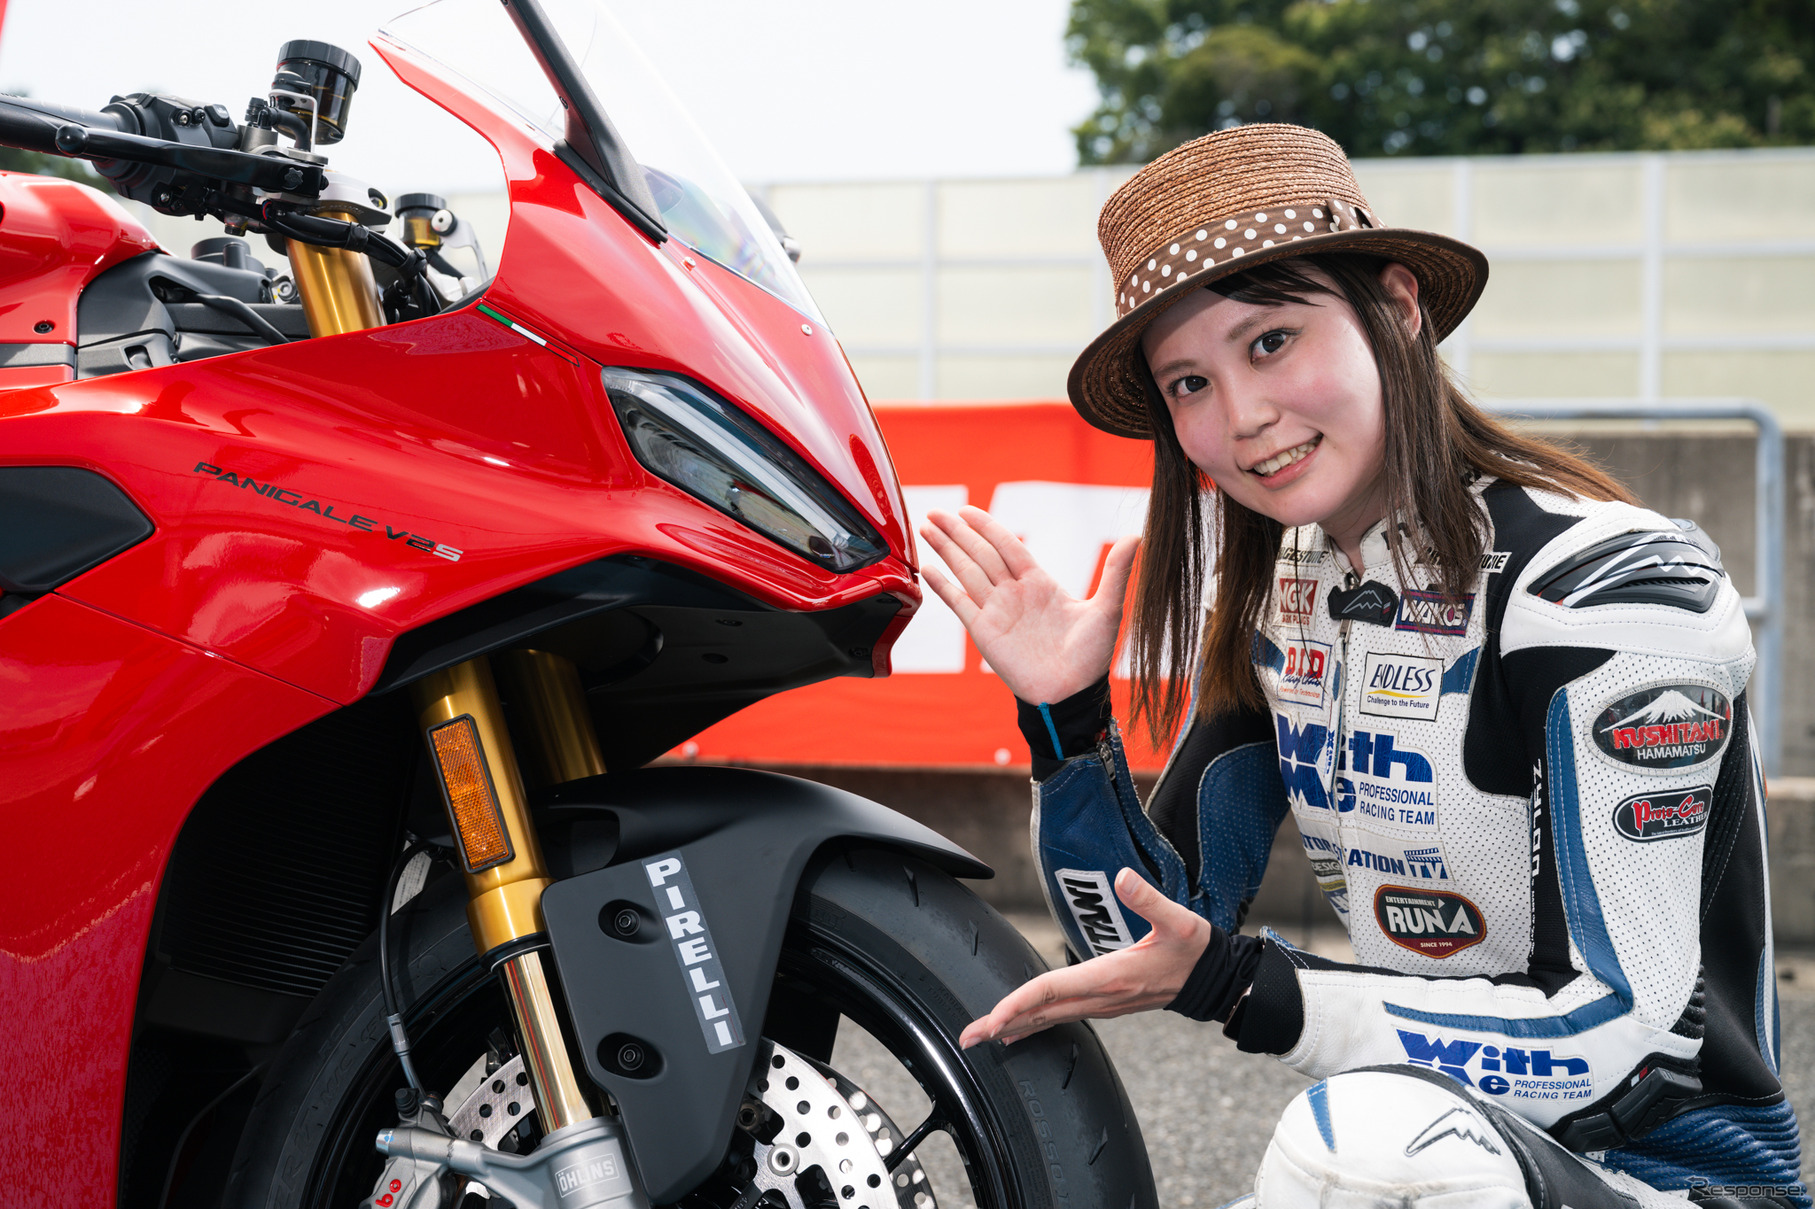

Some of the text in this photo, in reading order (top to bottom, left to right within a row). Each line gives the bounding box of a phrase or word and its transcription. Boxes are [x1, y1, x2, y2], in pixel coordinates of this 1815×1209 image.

[193, 461, 378, 533] PANIGALE
[1369, 664, 1436, 692] ENDLESS
[1409, 700, 1430, 709] Future
[1277, 713, 1433, 783] With
[1613, 719, 1720, 749] KUSHITANI
[1637, 744, 1706, 760] HAMAMATSU
[1359, 782, 1434, 806] PROFESSIONAL
[1360, 801, 1435, 825] RACING TEAM
[645, 857, 733, 1047] PIRELLI
[1396, 1029, 1589, 1077] With
[1514, 1078, 1592, 1090] PROFESSIONAL
[1514, 1089, 1592, 1099] RACING TEAM
[558, 1159, 615, 1192] ÖHLINS
